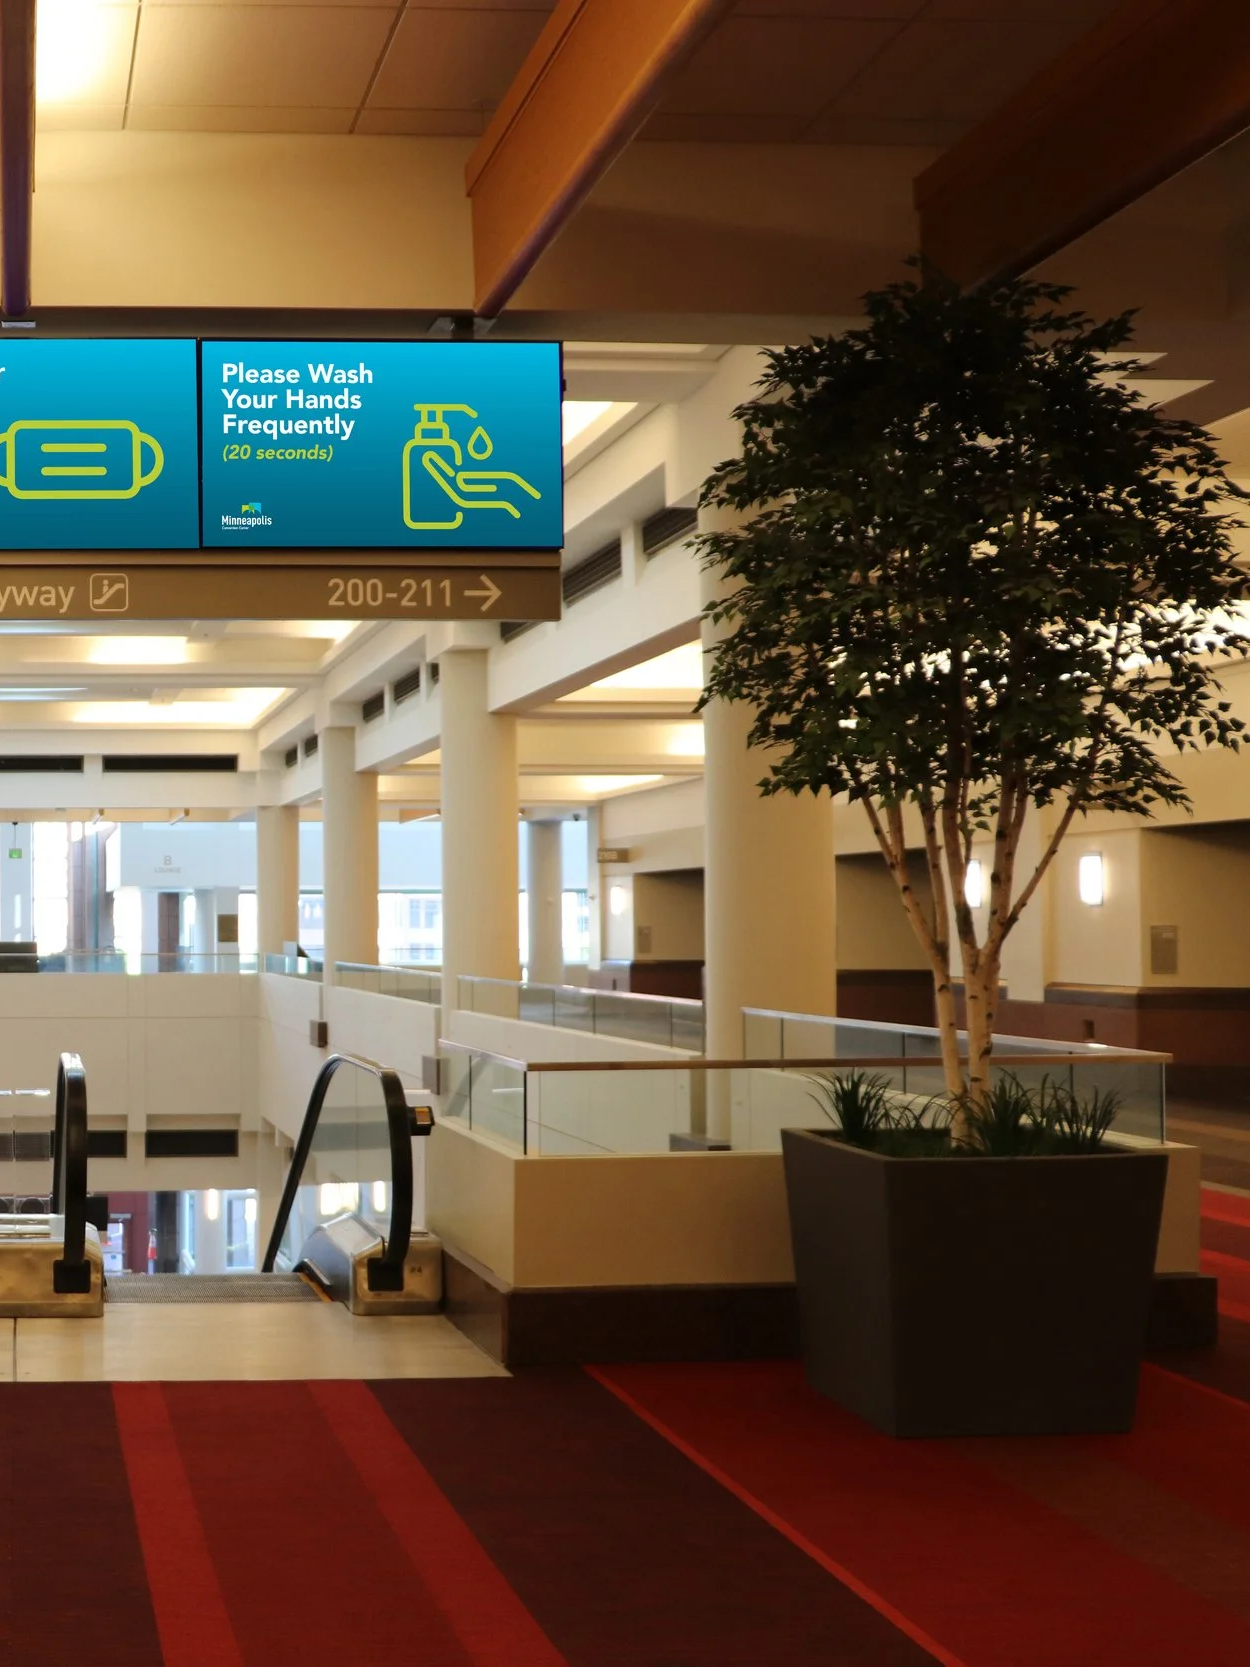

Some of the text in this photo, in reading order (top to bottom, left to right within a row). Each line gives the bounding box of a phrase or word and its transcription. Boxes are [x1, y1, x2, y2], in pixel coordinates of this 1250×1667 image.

[222, 362, 373, 384] Please Wash
[221, 387, 362, 409] Your Hands
[223, 413, 356, 441] Frequently
[222, 444, 334, 462] (20 seconds)
[221, 515, 272, 527] Minneapolis
[327, 577, 451, 607] 200-211
[164, 855, 172, 865] B
